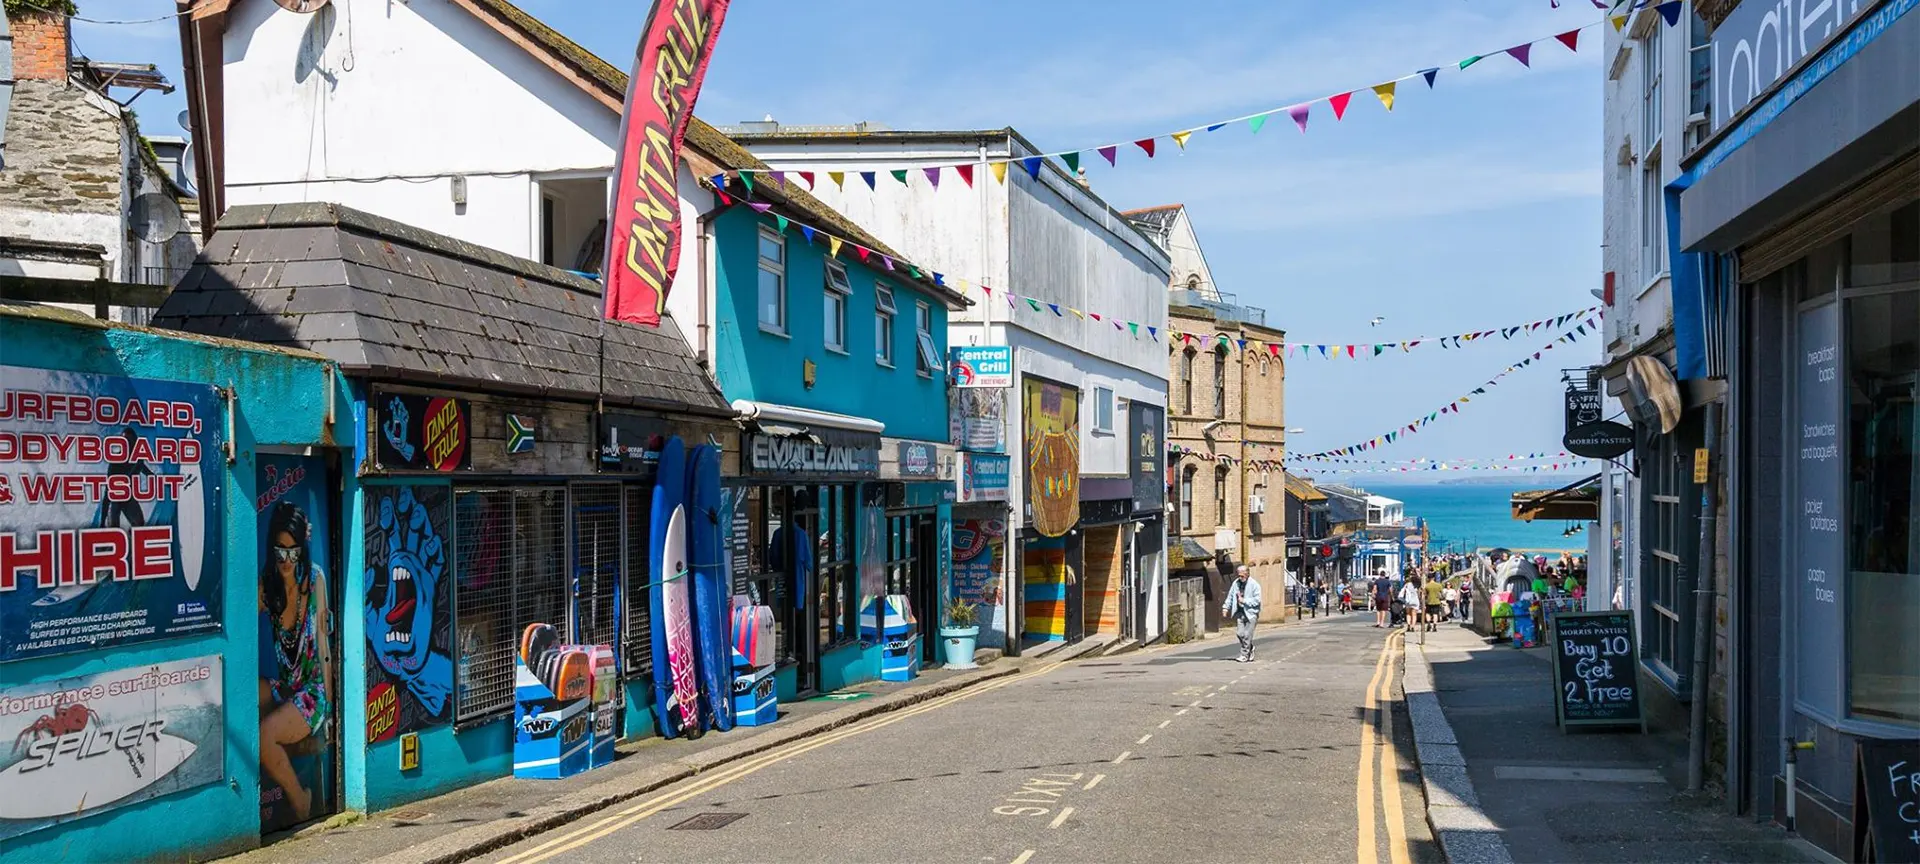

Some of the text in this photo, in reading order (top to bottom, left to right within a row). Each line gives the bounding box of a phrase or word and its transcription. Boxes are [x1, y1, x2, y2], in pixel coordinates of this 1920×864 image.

[625, 122, 677, 316] SANTA
[956, 350, 1007, 361] Central
[979, 362, 1007, 372] Grill
[424, 398, 457, 452] SANTA
[0, 432, 201, 464] ODYBOARD
[433, 421, 459, 470] CRUZ
[1569, 437, 1632, 446] MORRIS PASTIES
[0, 474, 184, 503] & WETSUIT
[1810, 517, 1838, 532] potatoes
[0, 525, 174, 592] HIRE
[29, 629, 60, 640] SURFED
[60, 627, 71, 636] BY
[82, 623, 107, 634] WORLD
[107, 618, 147, 631] CHAMPIONS
[31, 609, 148, 630] HIGH PERFORMANCE SURFBOARDS
[1594, 627, 1628, 635] PASTIES
[15, 639, 57, 651] AVAILABLE
[76, 631, 115, 644] COUNTRIES
[115, 626, 156, 638] WORLDWIDE
[1563, 636, 1631, 662] Buy 10
[108, 665, 211, 697] surfboards
[1576, 658, 1615, 679] Get
[1565, 679, 1633, 704] 2 Free
[366, 684, 396, 725] SANTA
[370, 705, 396, 744] CRUZ
[522, 718, 554, 734] TWF
